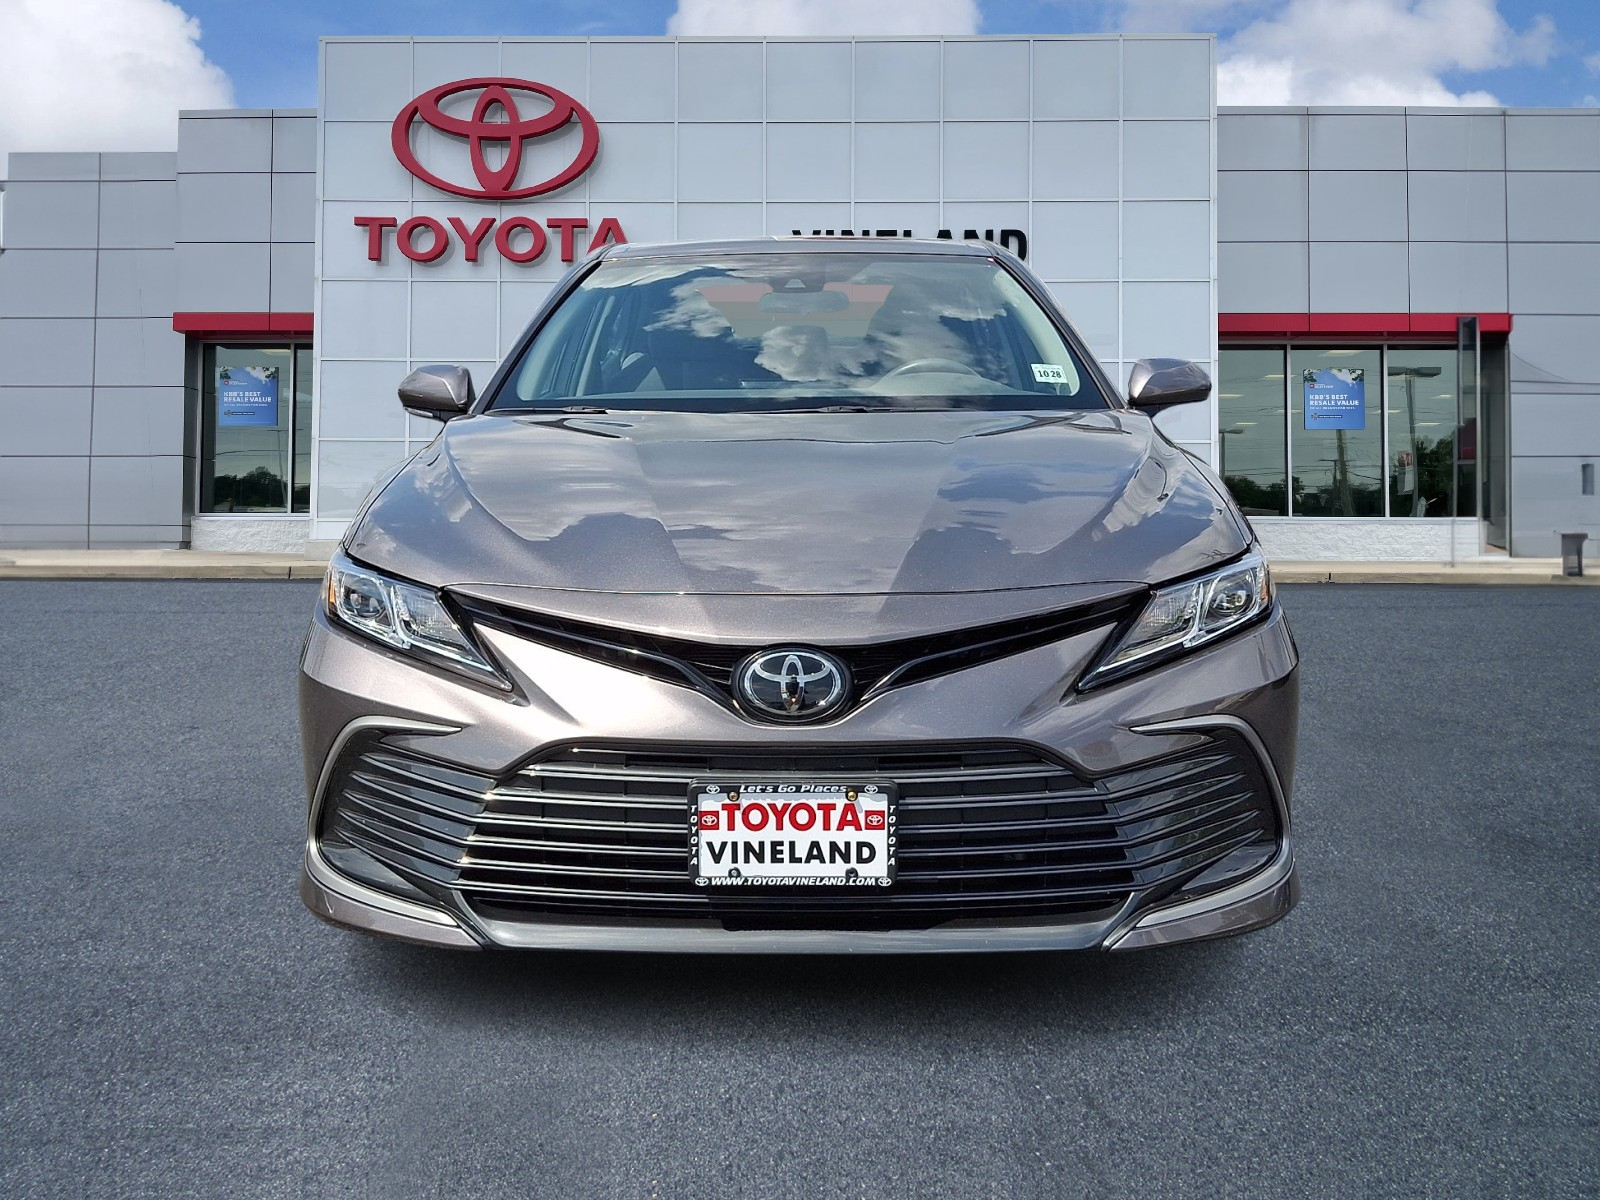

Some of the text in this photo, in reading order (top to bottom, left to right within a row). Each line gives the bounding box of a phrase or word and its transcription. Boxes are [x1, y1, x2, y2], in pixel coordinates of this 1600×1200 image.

[353, 215, 628, 263] TOYOTA
[739, 784, 847, 793] Let's Go Places
[721, 802, 863, 832] TOYOTA
[690, 805, 699, 866] TOYOTA
[888, 805, 897, 866] TOYOTA
[706, 841, 877, 865] VINELAND
[711, 876, 876, 886] WWW.TOYOTAVINELAND.COM
